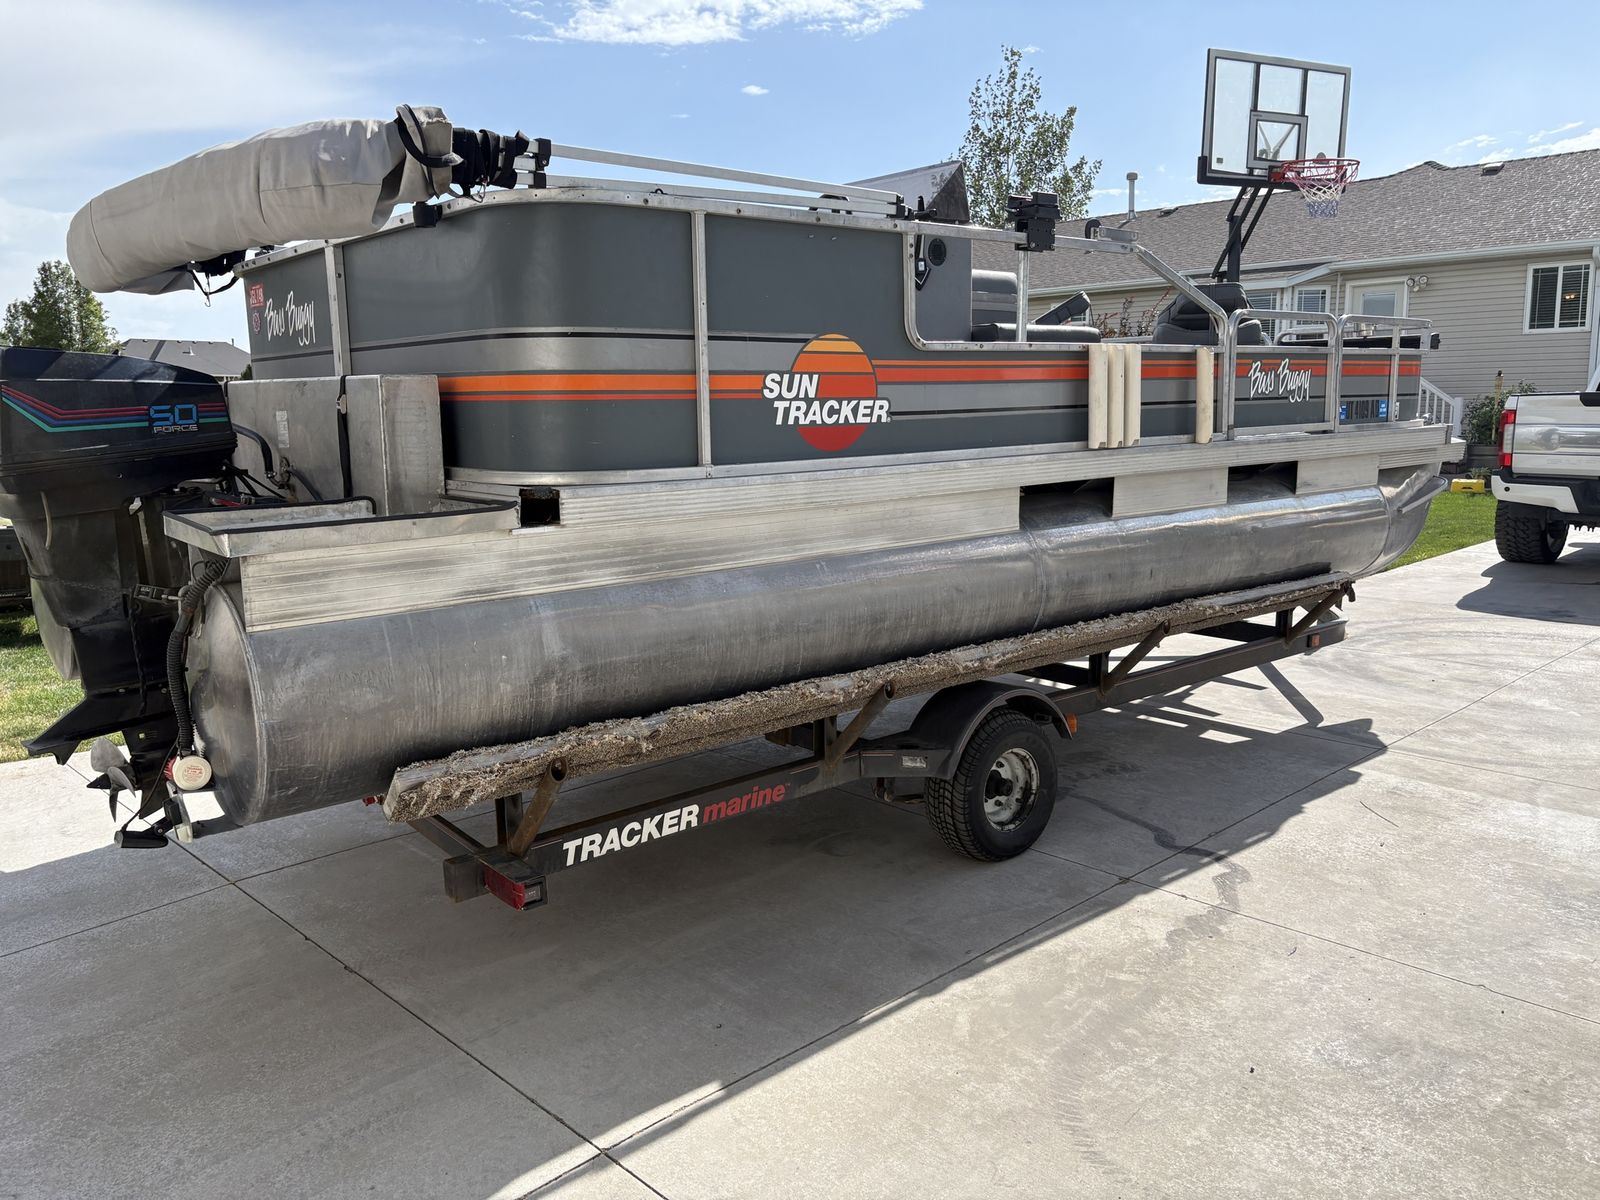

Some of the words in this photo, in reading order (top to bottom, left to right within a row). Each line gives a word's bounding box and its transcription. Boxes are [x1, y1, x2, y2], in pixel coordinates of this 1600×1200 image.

[264, 298, 285, 342] Bass
[285, 290, 316, 347] Buggy
[762, 372, 819, 399] SUN
[1248, 360, 1275, 398] Bass
[1277, 358, 1312, 403] Buggy
[149, 403, 197, 427] 50
[773, 399, 890, 426] TRACKER
[153, 424, 199, 434] FORCE
[562, 803, 700, 867] TRACKER
[702, 783, 786, 824] marine
